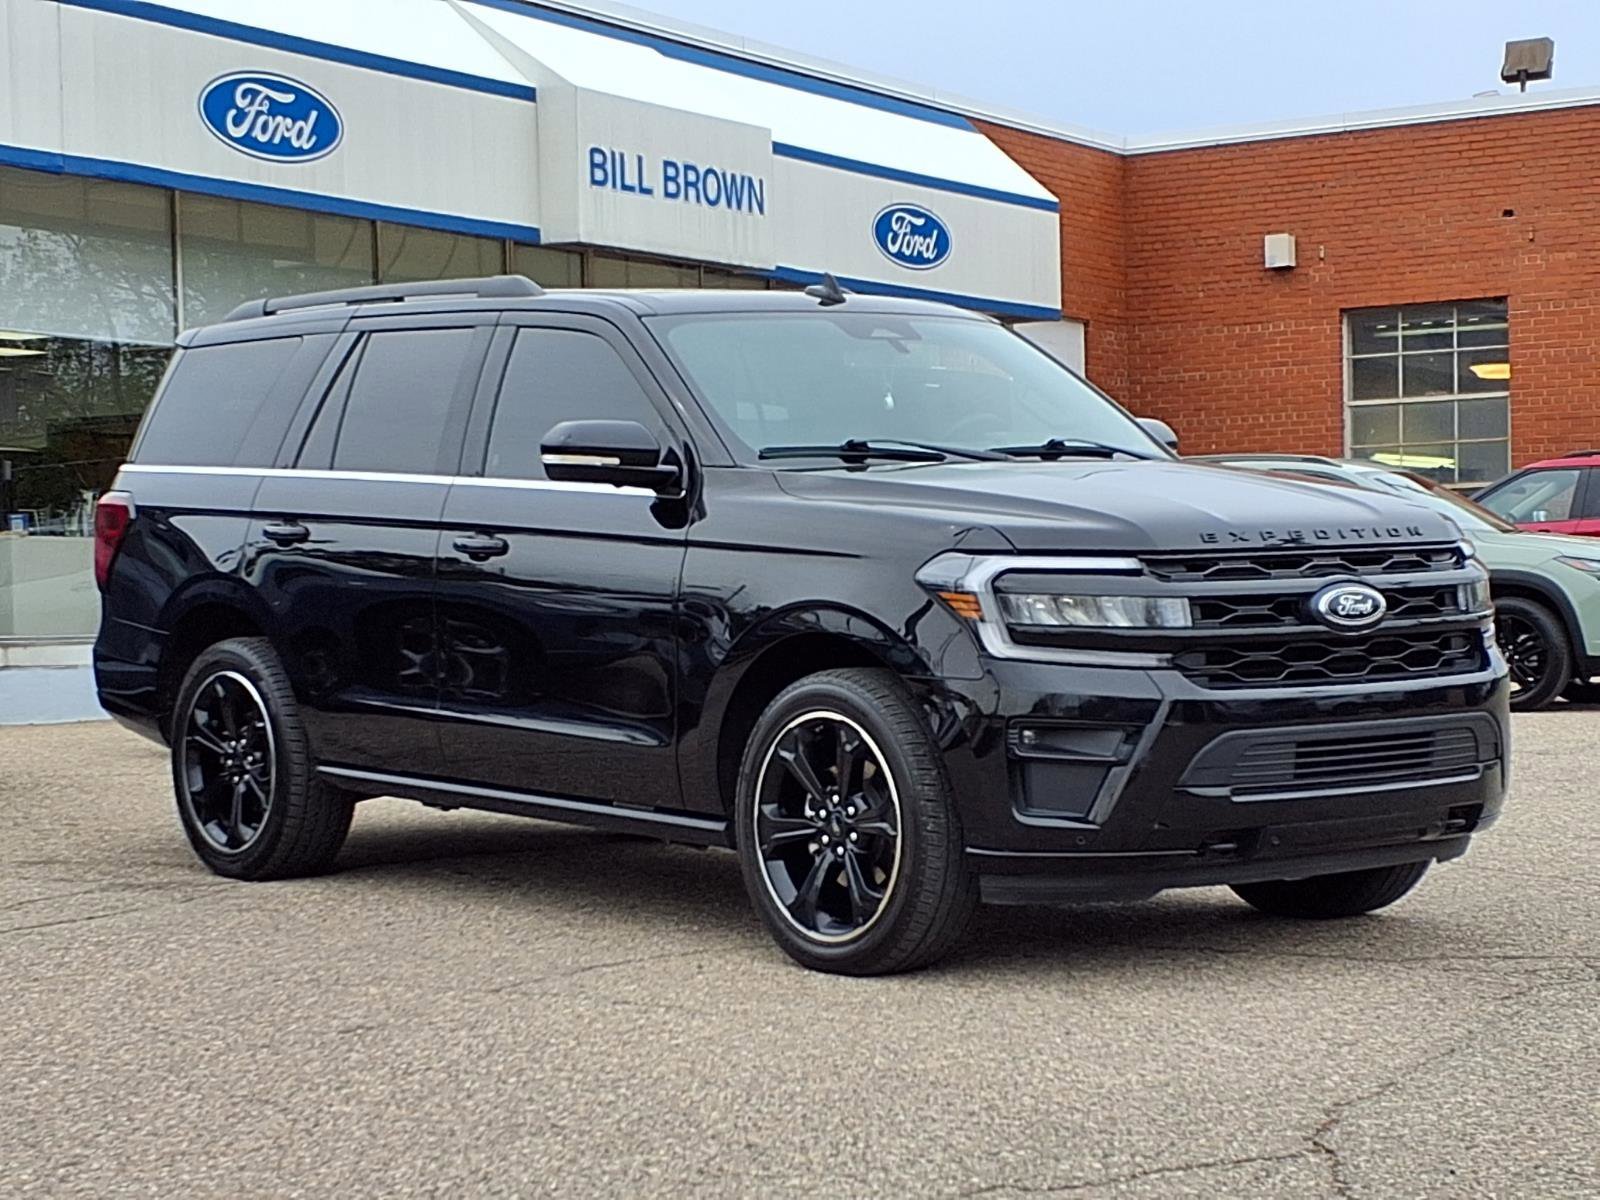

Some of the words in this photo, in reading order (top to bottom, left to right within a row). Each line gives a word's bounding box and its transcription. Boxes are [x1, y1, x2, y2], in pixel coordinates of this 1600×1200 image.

[226, 82, 318, 150] Ford
[589, 147, 653, 195] BILL
[663, 160, 764, 215] BROWN
[888, 211, 938, 260] Ford
[1200, 526, 1423, 544] EXPEDITION
[1336, 594, 1373, 616] Ford
